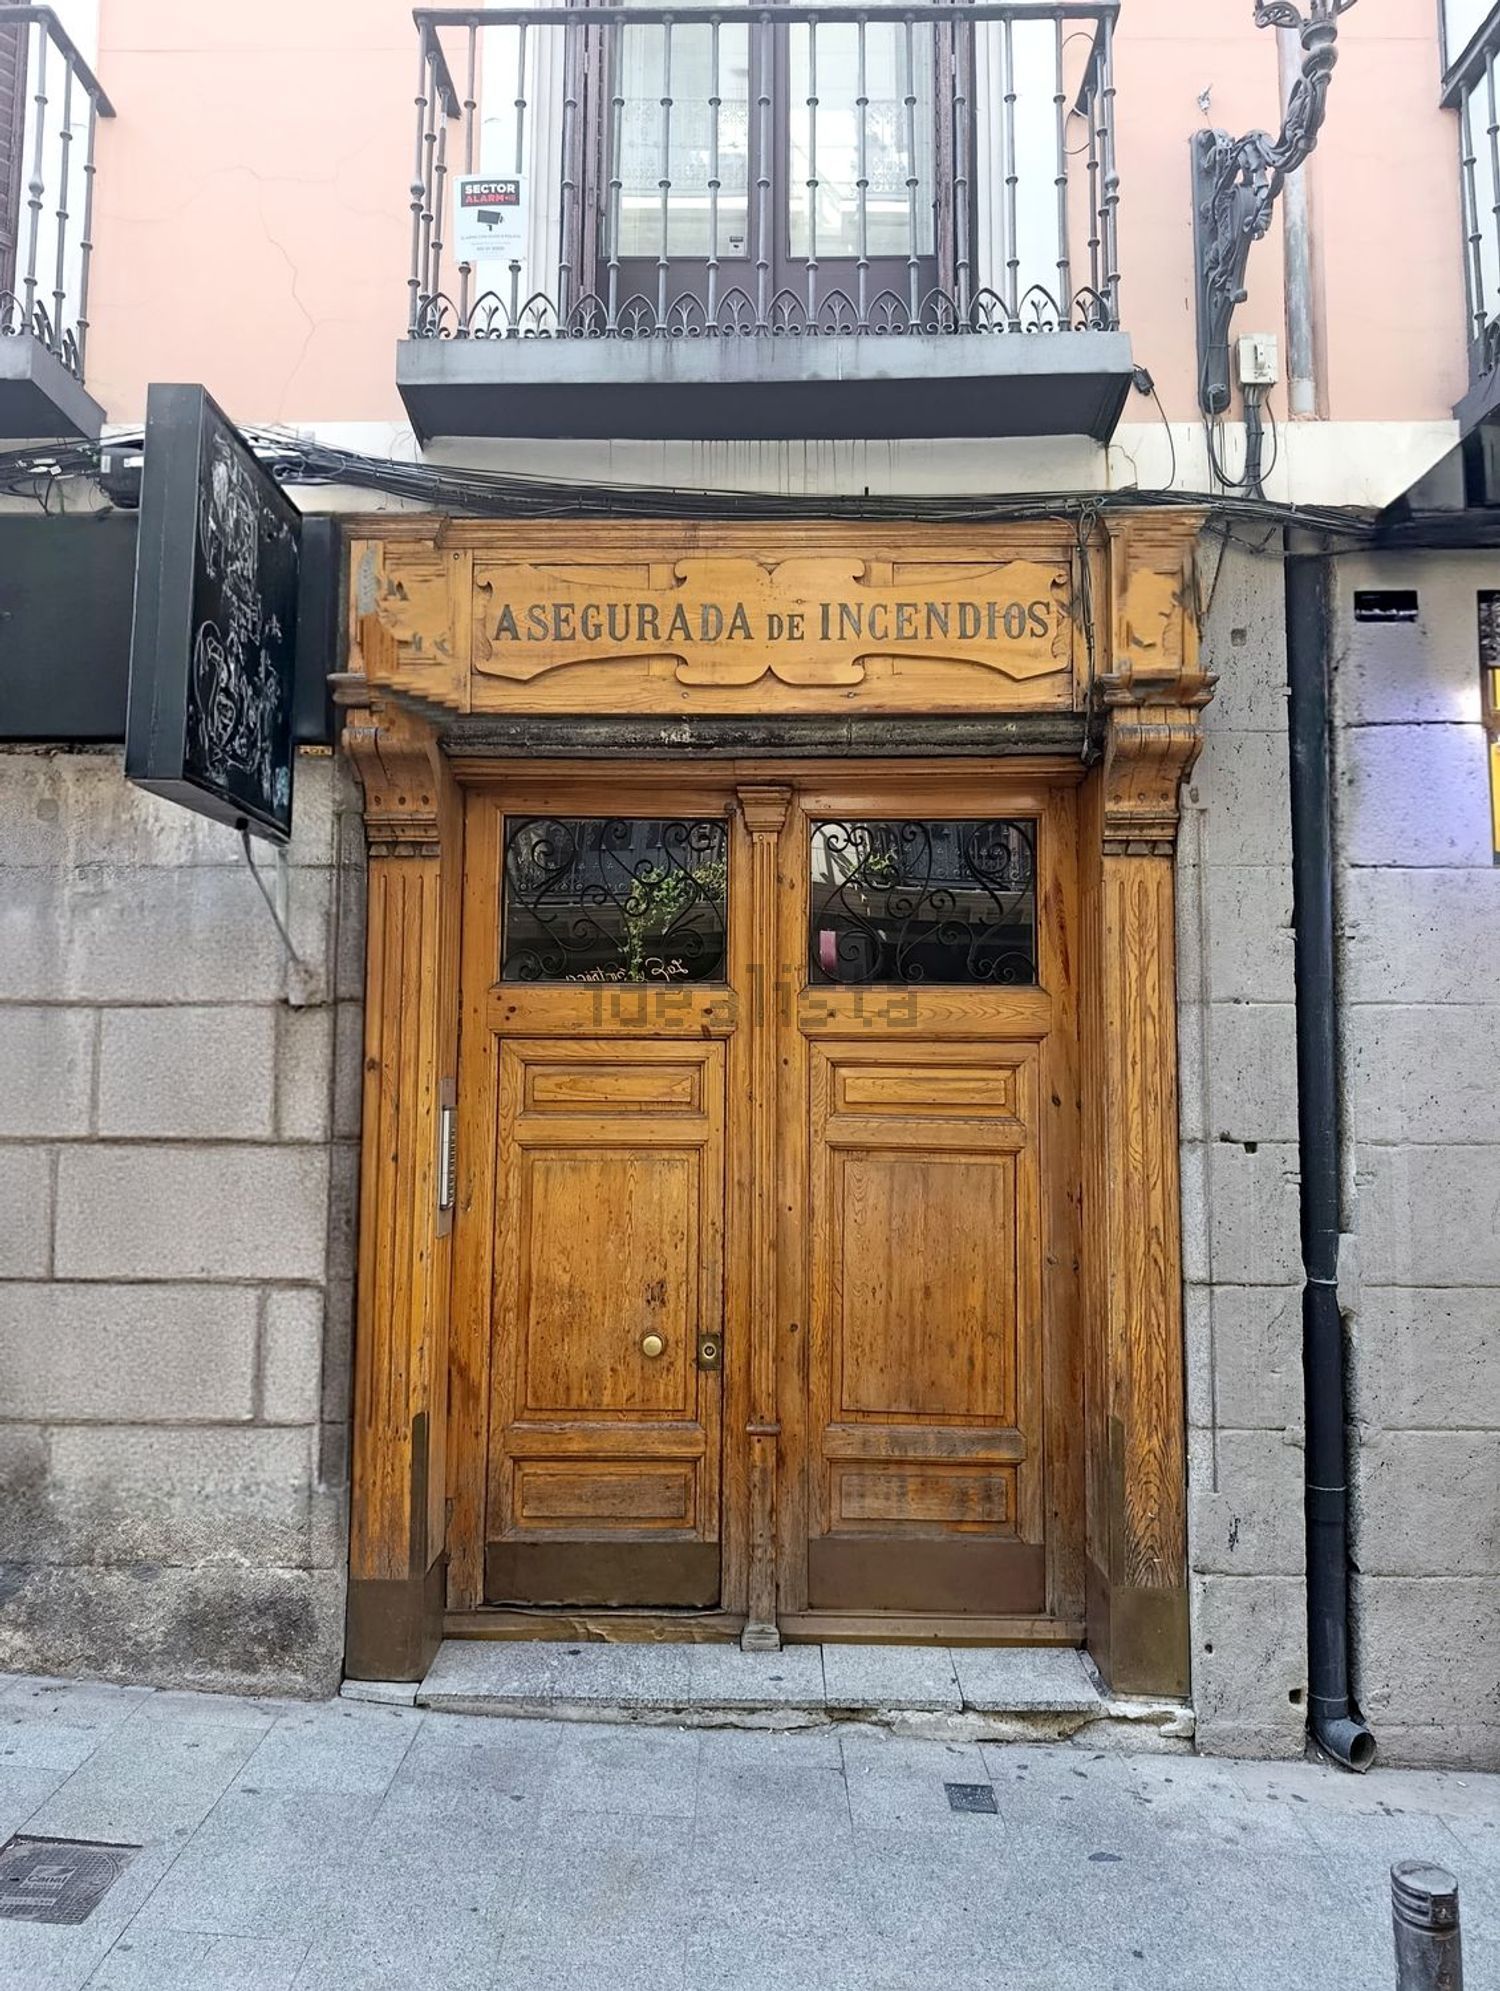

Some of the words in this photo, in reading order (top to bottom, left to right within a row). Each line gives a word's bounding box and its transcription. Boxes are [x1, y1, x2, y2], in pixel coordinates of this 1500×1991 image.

[465, 183, 515, 194] SECTOR
[465, 194, 505, 203] ALARM
[493, 602, 754, 641] ASEGURADA
[767, 613, 805, 640] DE
[819, 600, 1050, 640] INCENDIOS
